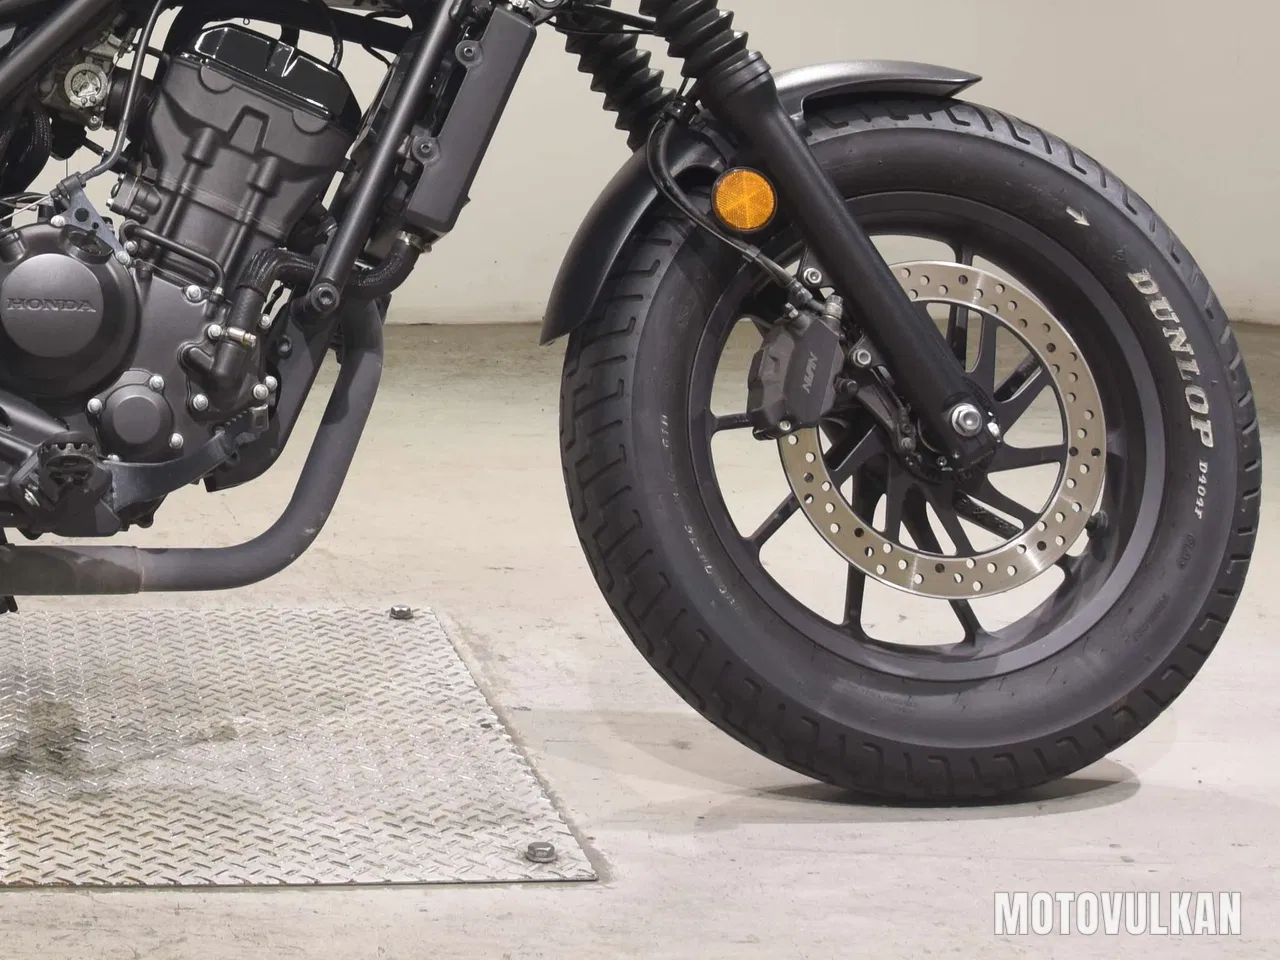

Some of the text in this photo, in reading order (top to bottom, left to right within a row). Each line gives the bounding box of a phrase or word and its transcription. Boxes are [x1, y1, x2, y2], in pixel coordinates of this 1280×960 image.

[6, 297, 97, 313] HONDA
[1127, 268, 1214, 520] DUNLOP D404F
